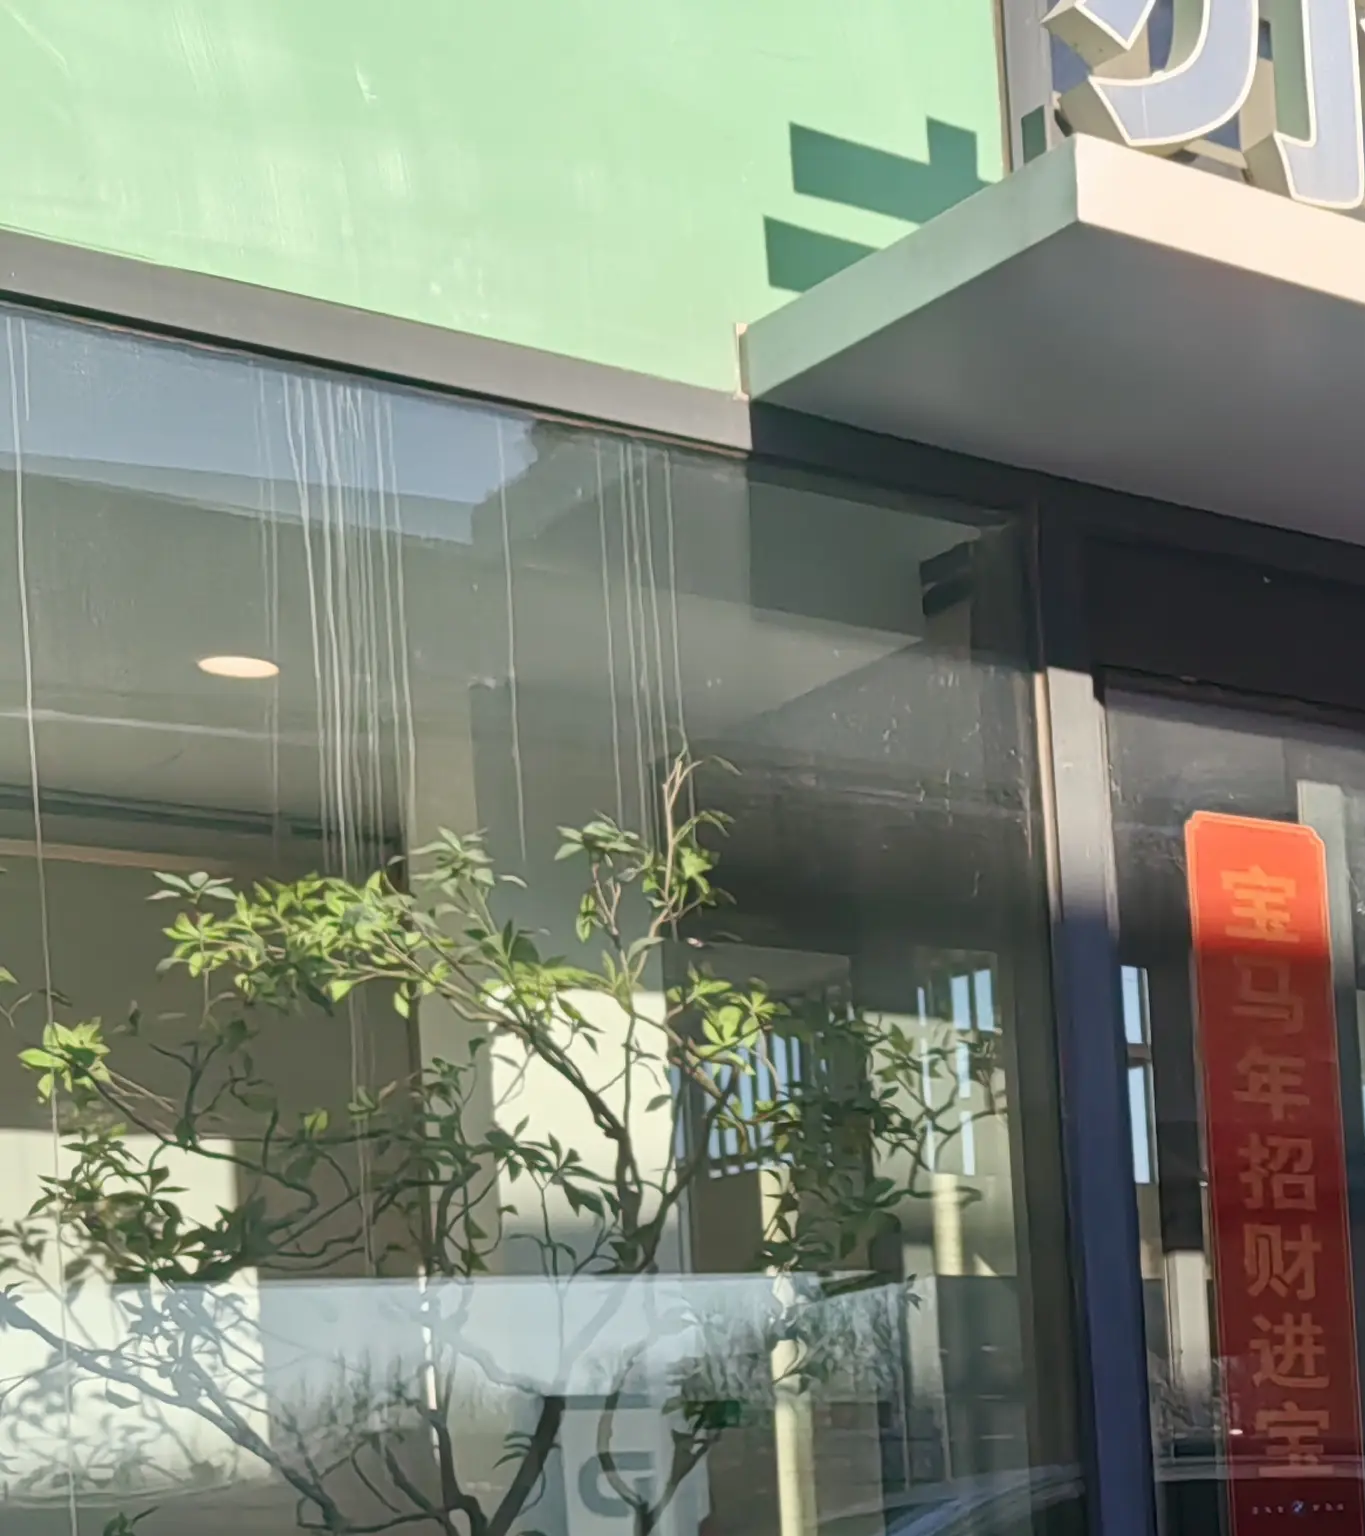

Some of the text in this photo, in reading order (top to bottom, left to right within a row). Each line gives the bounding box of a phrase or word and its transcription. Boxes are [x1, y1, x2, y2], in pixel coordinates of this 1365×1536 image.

[1219, 863, 1336, 1481] 宝马年招财进宝
